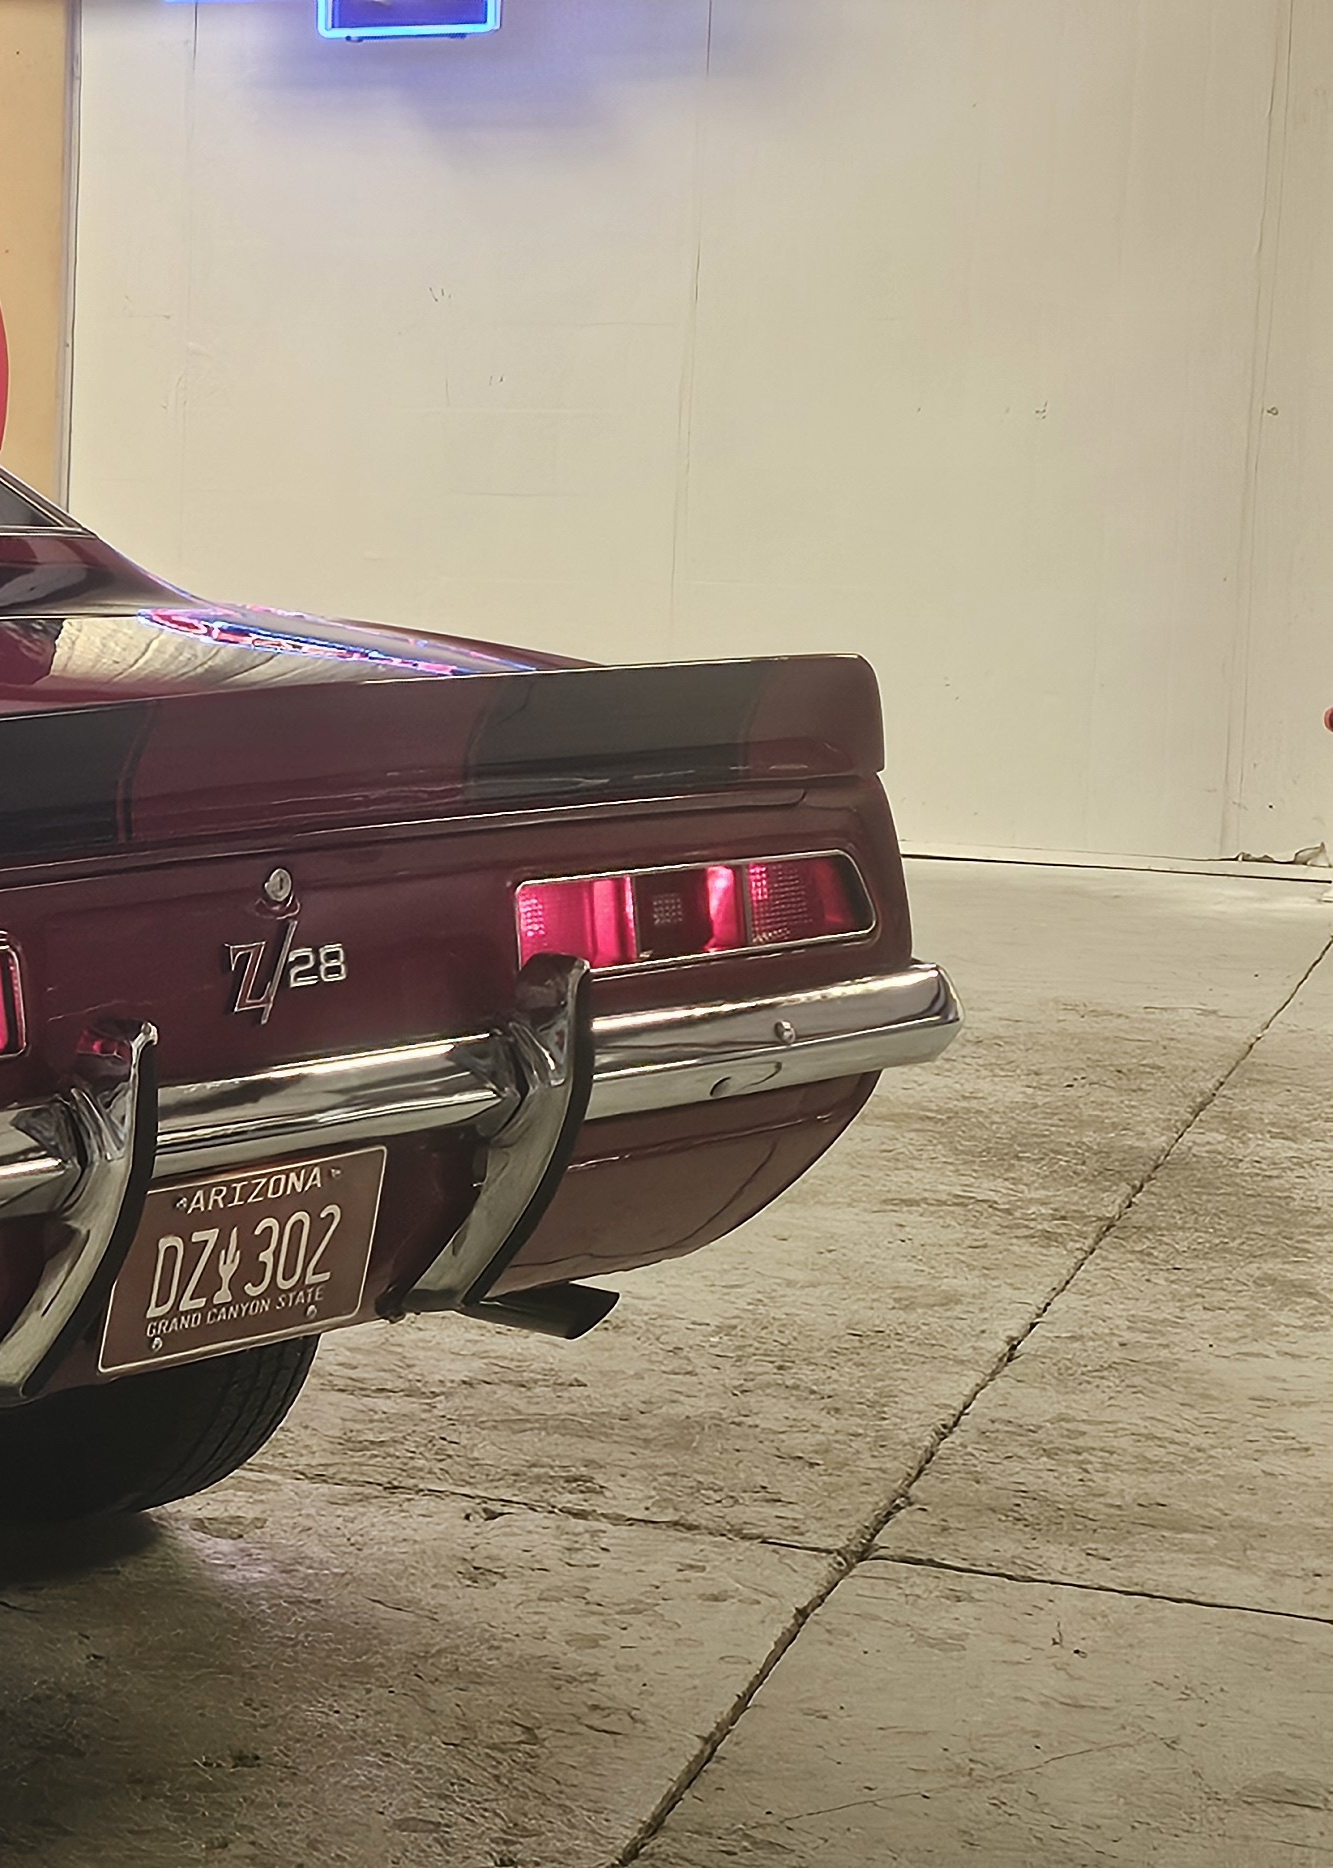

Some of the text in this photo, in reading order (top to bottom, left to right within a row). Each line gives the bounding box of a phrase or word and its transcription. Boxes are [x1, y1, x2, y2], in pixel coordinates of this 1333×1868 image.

[187, 1166, 323, 1214] ARIZONA
[146, 1284, 325, 1338] GRAND CANYON STATE
